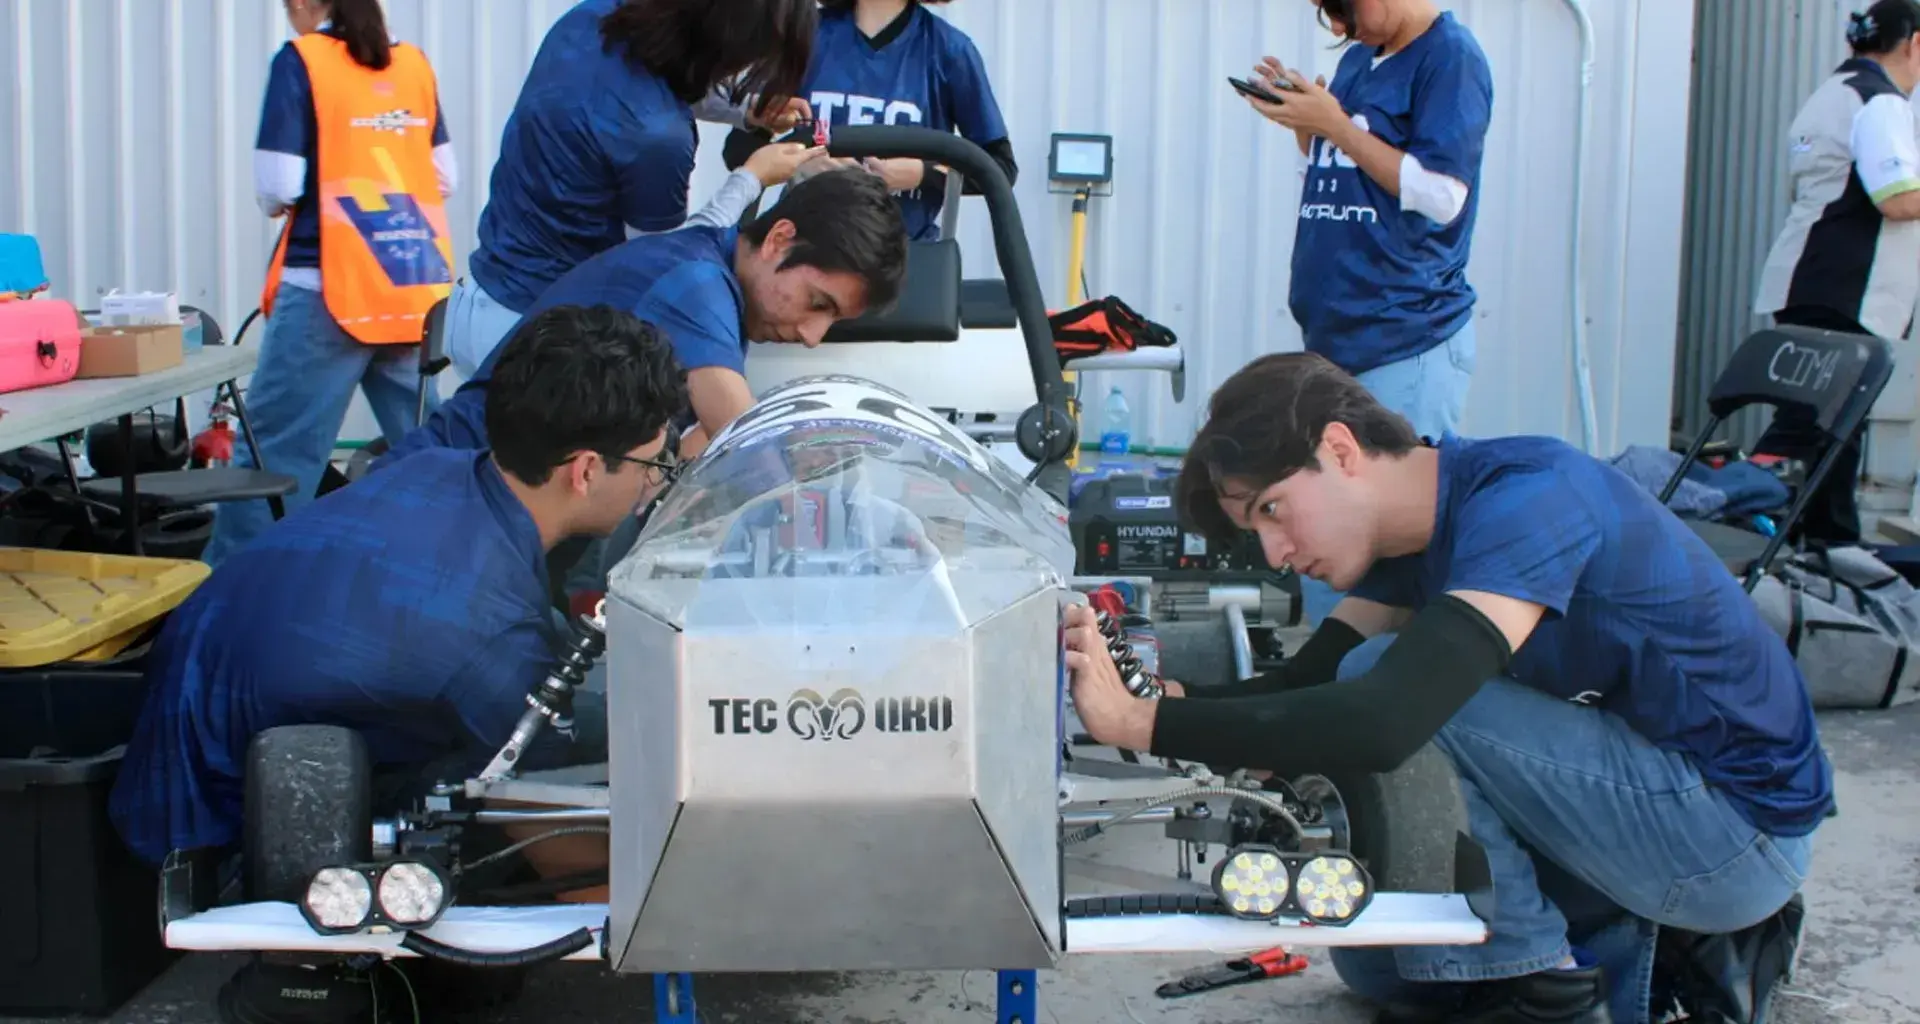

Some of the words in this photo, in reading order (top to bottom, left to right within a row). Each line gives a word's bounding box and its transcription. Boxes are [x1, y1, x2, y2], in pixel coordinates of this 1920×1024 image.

[1768, 341, 1841, 391] CIMA
[1116, 526, 1178, 537] HYUNDAI
[708, 698, 778, 734] TEC
